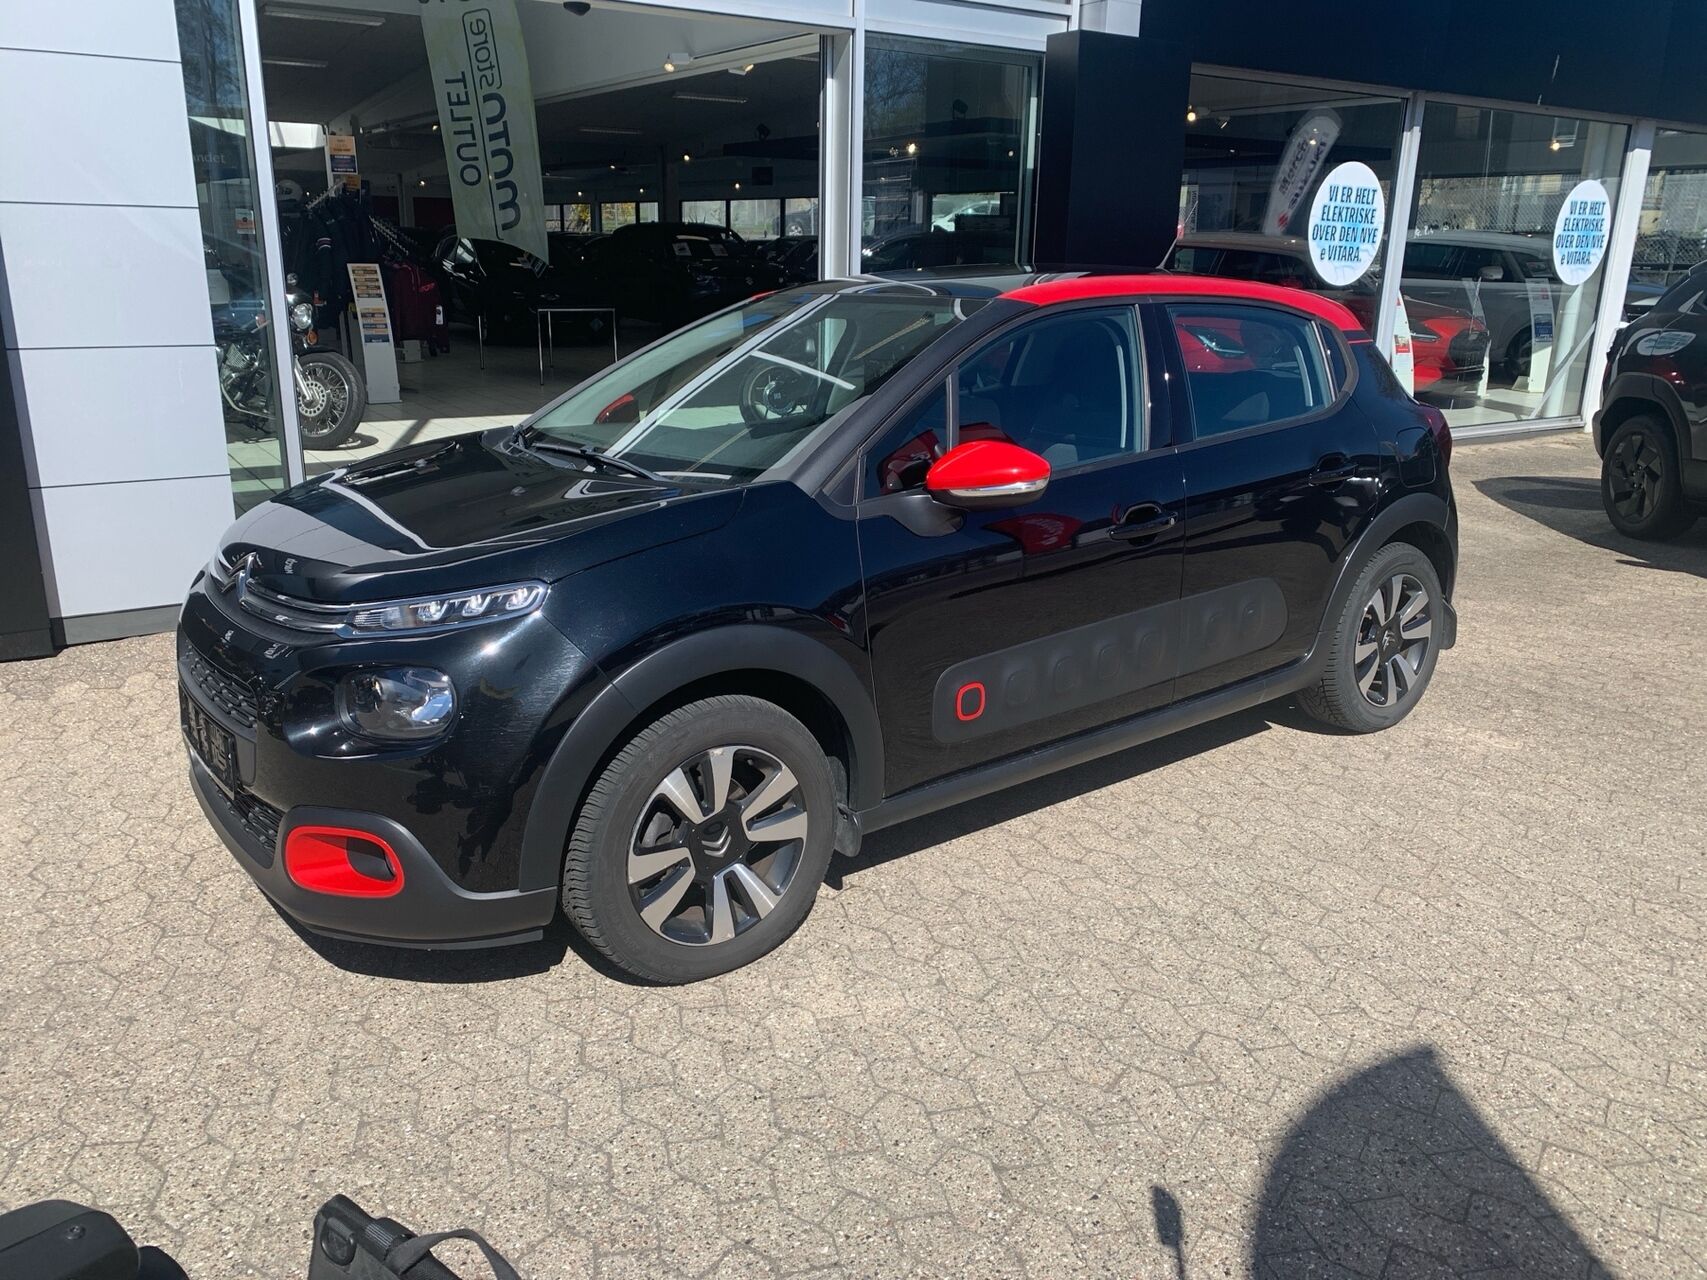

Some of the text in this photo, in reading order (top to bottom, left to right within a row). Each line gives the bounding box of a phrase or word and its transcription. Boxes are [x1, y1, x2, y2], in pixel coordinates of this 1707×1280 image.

[1329, 185, 1378, 205] VI ER HELT
[1321, 204, 1376, 224] ELEKTRISKE
[1570, 201, 1606, 215] VI ER HELT
[1563, 217, 1605, 232] ELEKTRISKE
[1312, 223, 1378, 244] OVER DEN NYE
[1556, 234, 1605, 249] OVER DEN NYE
[1320, 245, 1362, 262] e VITARA.
[1561, 253, 1566, 265] e
